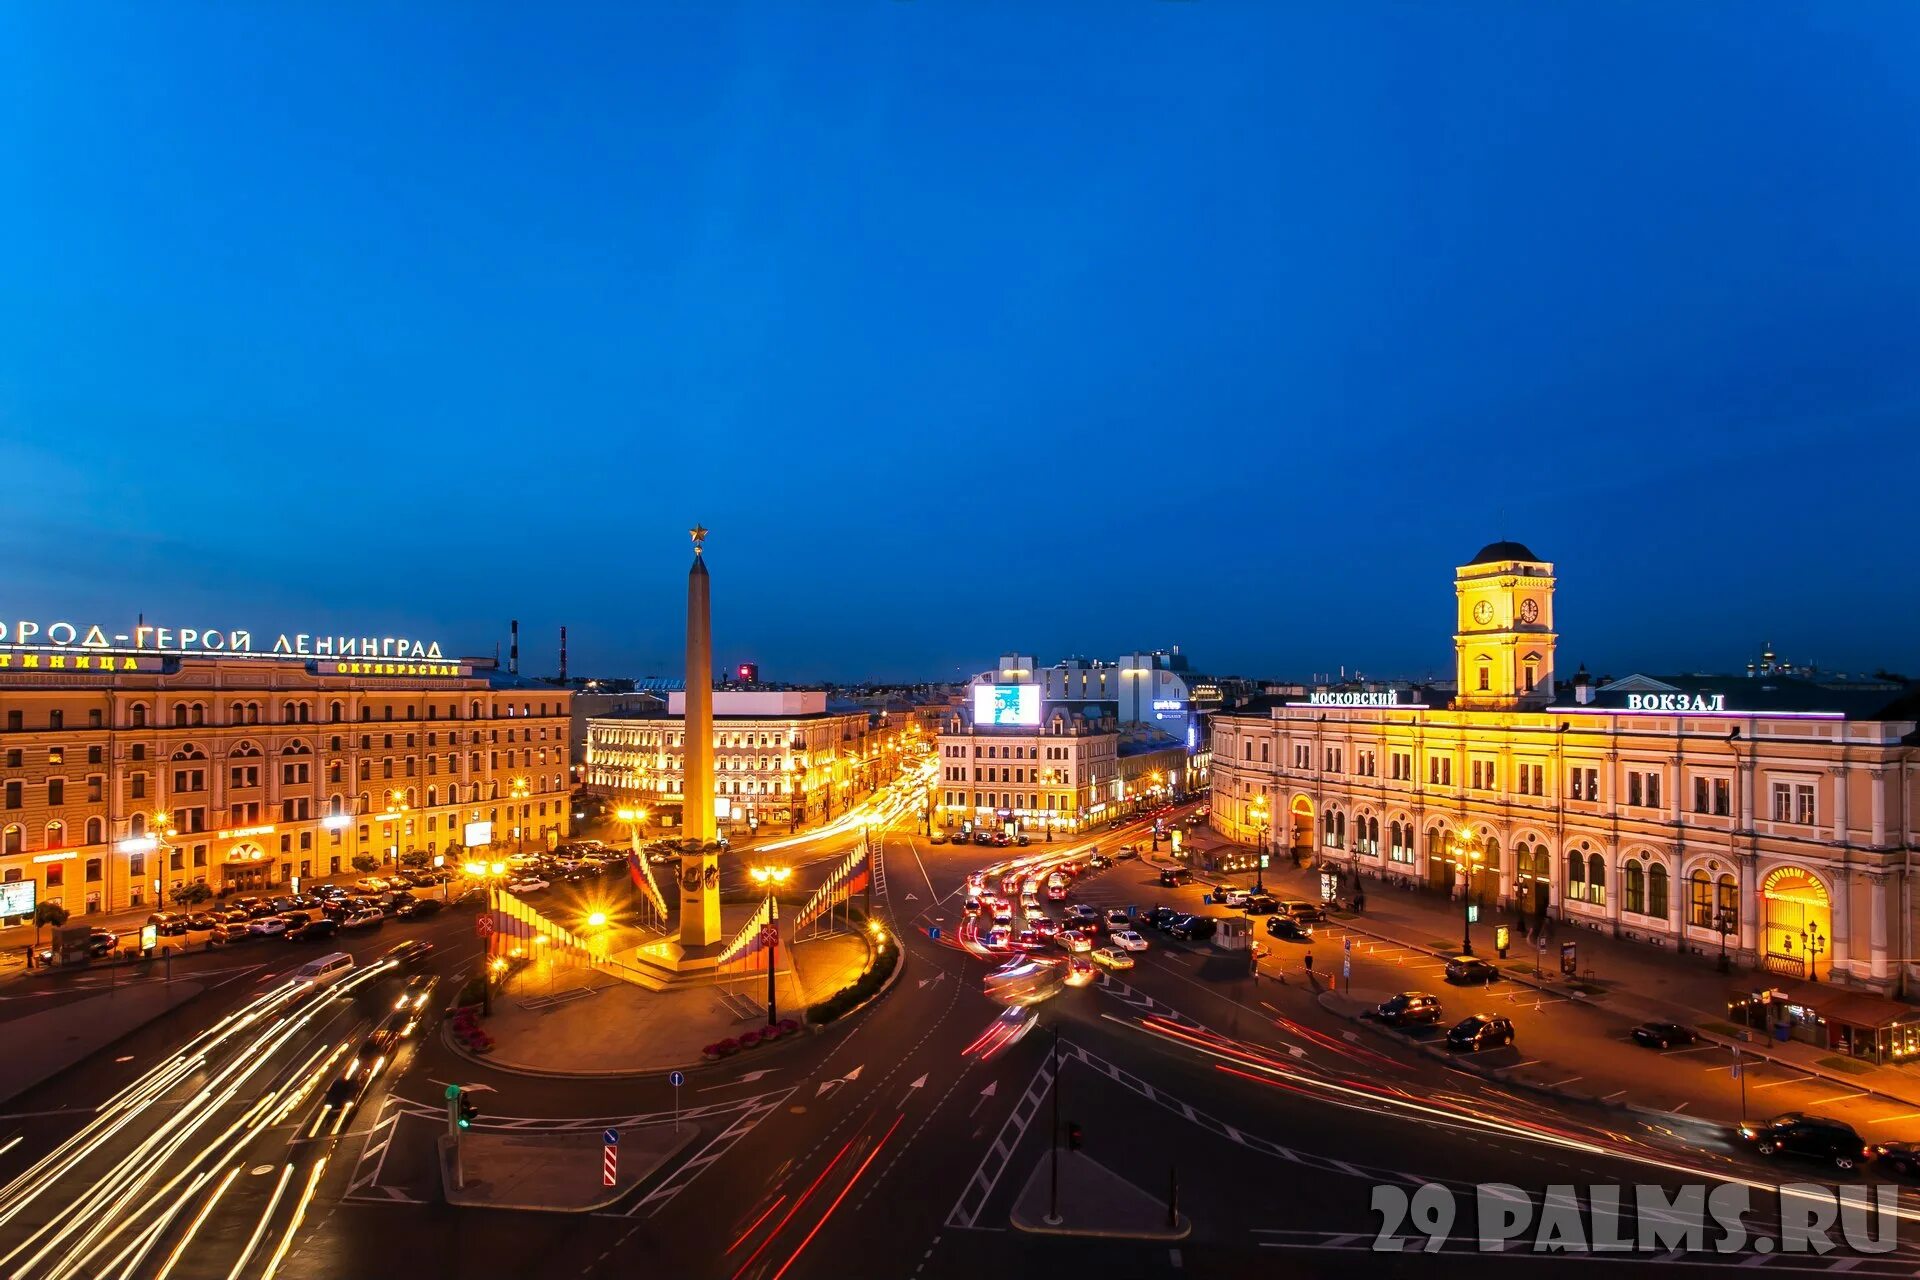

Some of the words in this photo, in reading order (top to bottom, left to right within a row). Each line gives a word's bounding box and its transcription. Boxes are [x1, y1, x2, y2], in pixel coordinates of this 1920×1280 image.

[0, 621, 251, 651] РОД-ГЕРОЙ
[272, 633, 443, 658] ЛЕНИНГРАД
[0, 654, 138, 671] ТИНИЦА
[337, 662, 459, 676] ОКТЯБРЬСКАЯ
[1310, 689, 1397, 705] МОСКОВСКИЙ
[1628, 694, 1724, 711] ВОКЗАЛ
